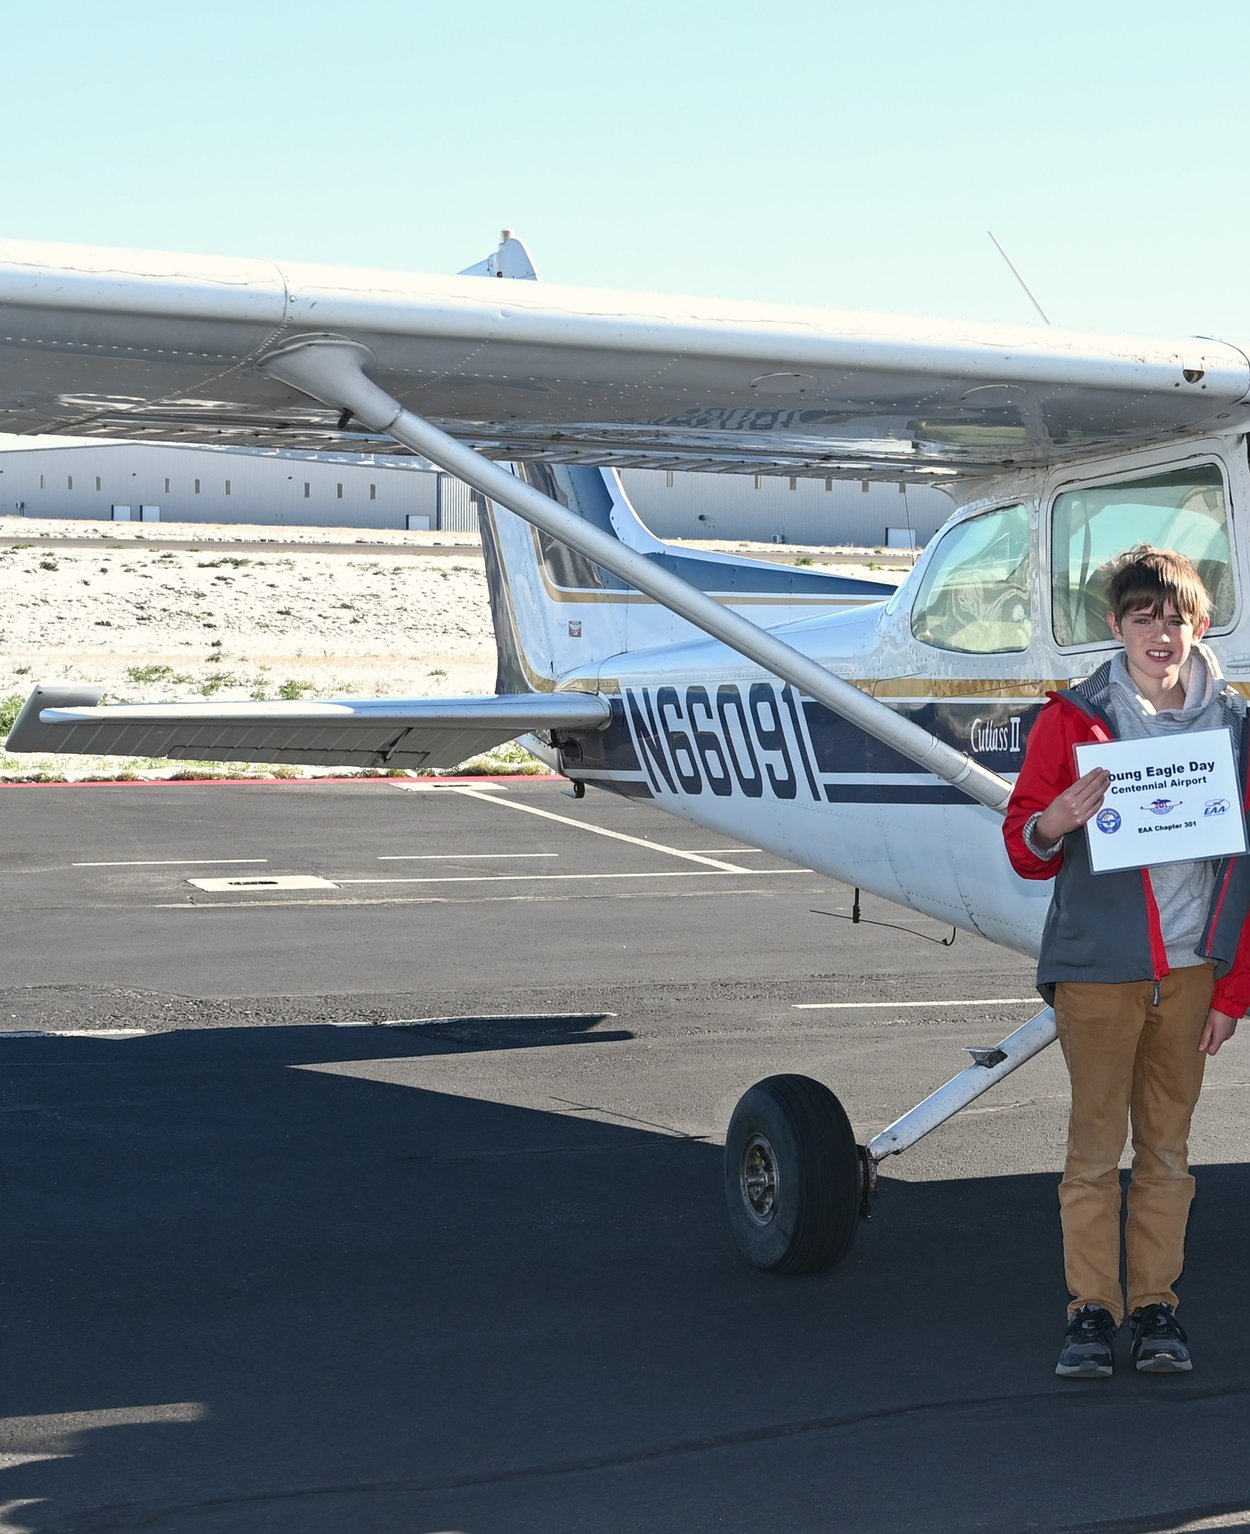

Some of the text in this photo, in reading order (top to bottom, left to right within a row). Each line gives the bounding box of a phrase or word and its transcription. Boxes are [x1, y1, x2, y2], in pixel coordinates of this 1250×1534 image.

[626, 682, 822, 801] N66091
[970, 717, 1021, 752] Cutlass II
[1108, 761, 1215, 781] oung Eagle Day
[1111, 775, 1207, 794] Centennial Airport
[1204, 805, 1225, 815] EAA
[1154, 823, 1182, 831] Chapter
[1184, 820, 1197, 828] 301
